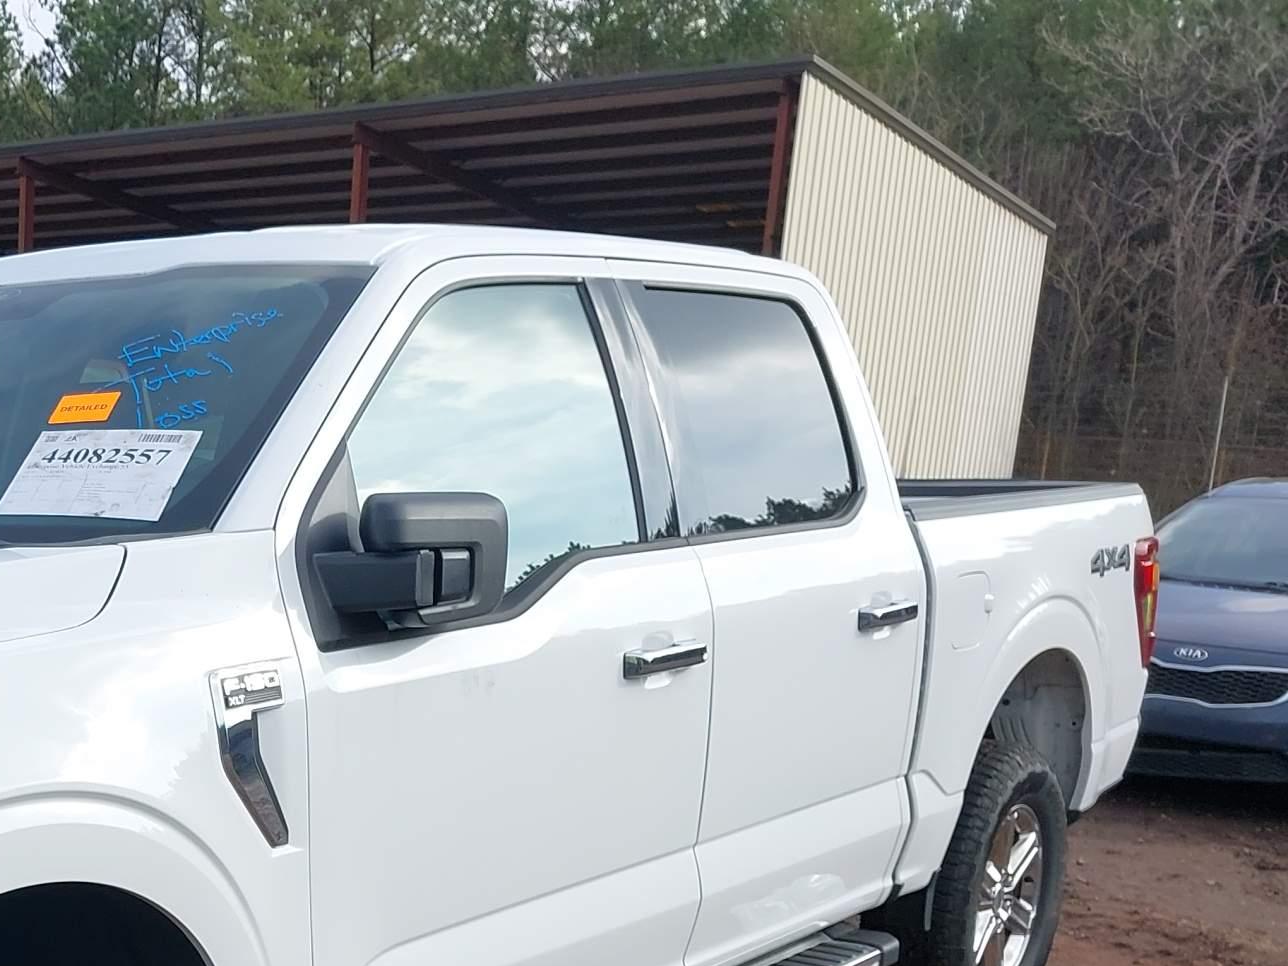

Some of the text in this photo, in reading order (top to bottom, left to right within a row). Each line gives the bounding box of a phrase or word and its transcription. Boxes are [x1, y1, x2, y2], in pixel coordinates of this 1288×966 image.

[59, 403, 108, 413] DETAILED
[41, 448, 173, 465] 44082557
[1179, 648, 1202, 659] KIA
[228, 694, 246, 707] XLT
